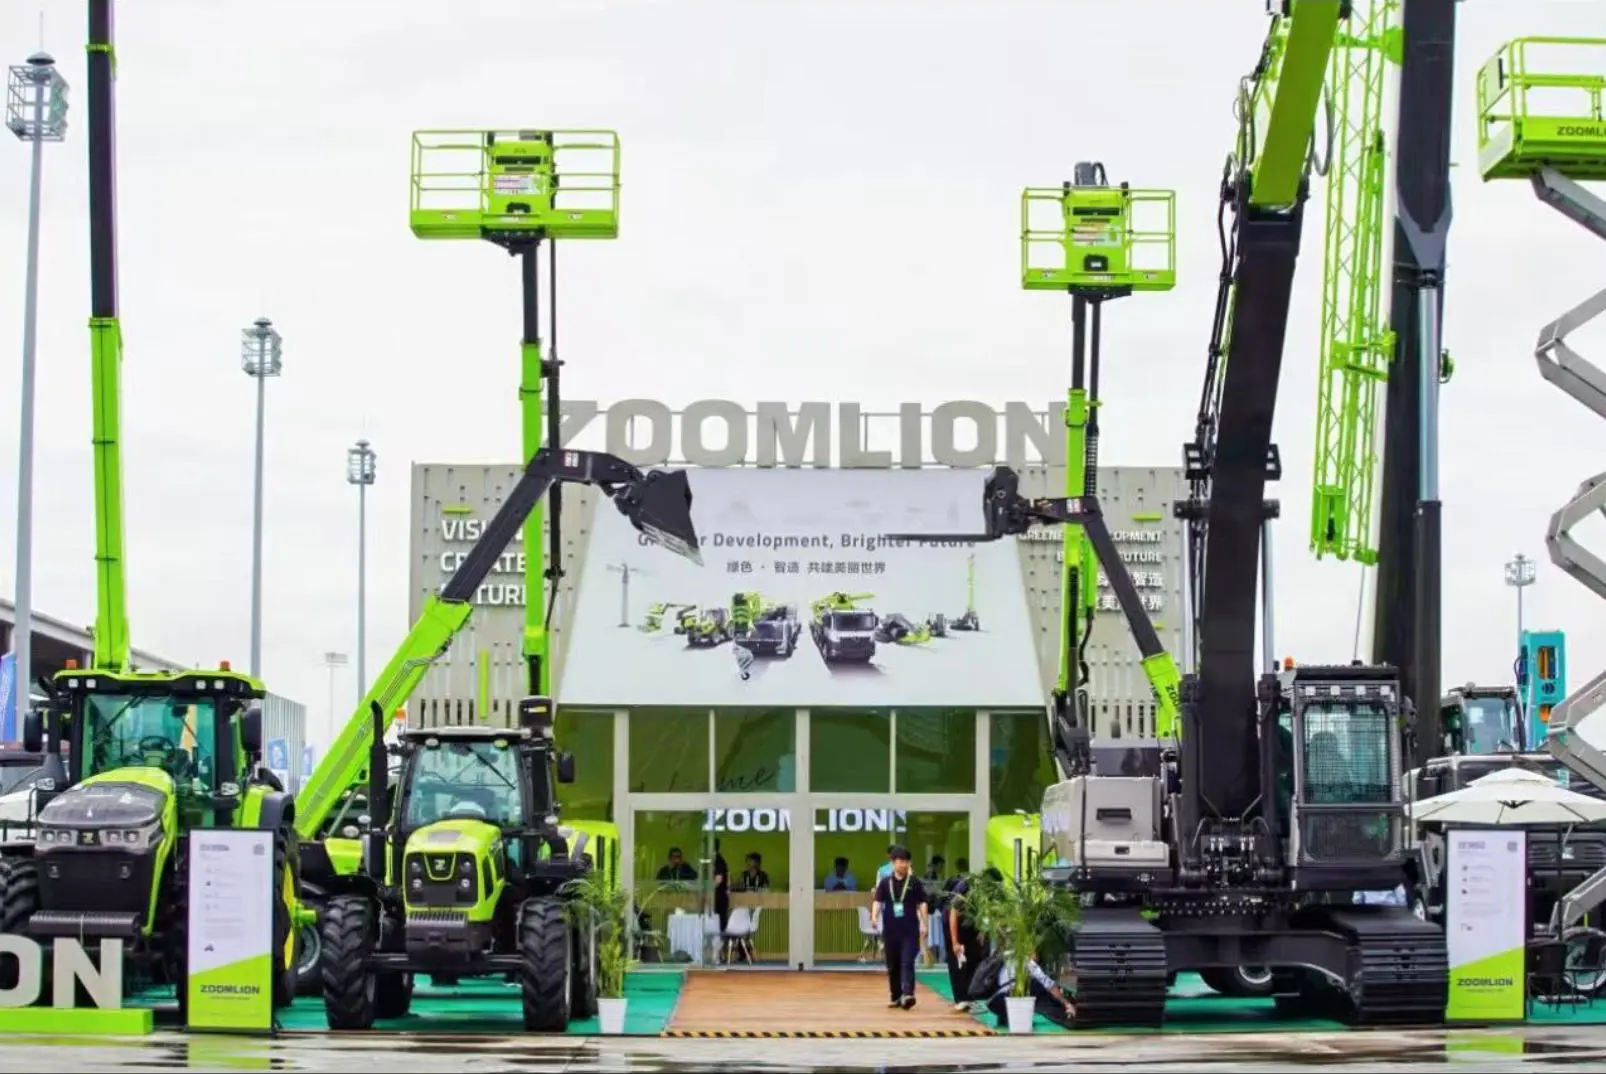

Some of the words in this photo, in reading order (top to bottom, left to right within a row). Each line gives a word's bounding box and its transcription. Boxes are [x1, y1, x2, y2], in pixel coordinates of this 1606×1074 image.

[543, 399, 1066, 468] ZOOMLION
[441, 519, 524, 540] VISI
[713, 533, 833, 550] Development,
[841, 533, 911, 551] Brighter
[440, 551, 527, 572] CRTE
[200, 984, 260, 995] ZOOMLION
